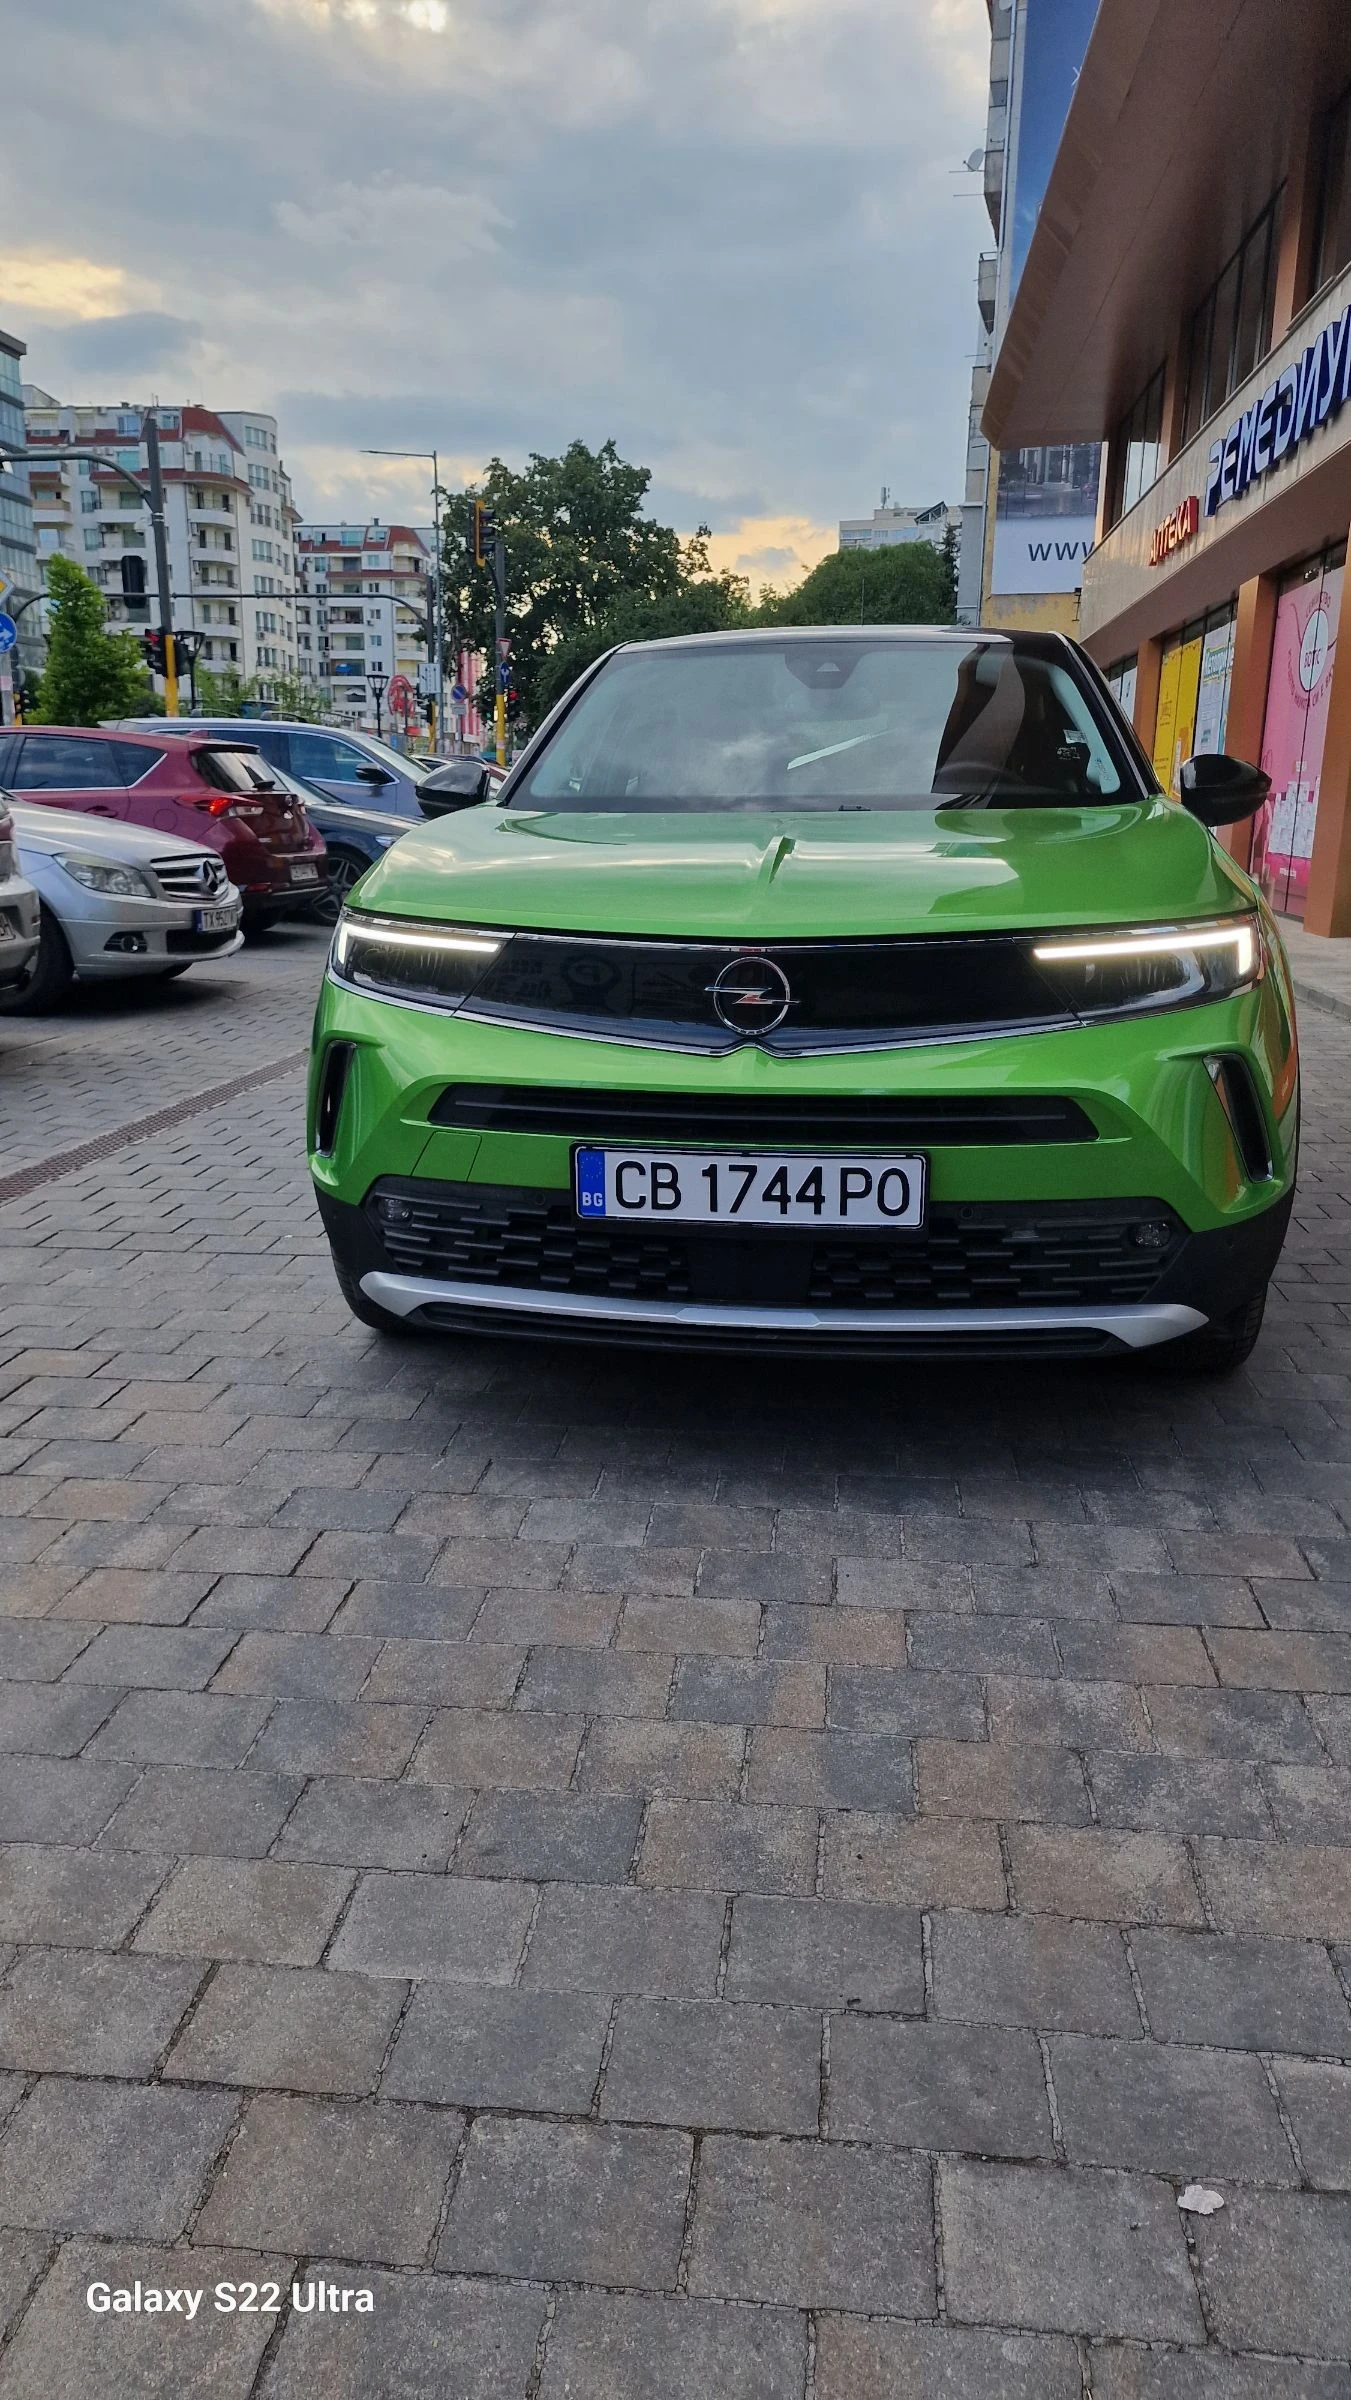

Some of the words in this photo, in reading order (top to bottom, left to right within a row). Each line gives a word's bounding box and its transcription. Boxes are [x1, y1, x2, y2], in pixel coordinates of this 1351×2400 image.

[1204, 305, 1351, 517] РЕМЕДИУ
[1149, 496, 1198, 566] АПТЕКА
[582, 1191, 604, 1207] BG
[615, 1160, 682, 1211] CB
[701, 1163, 826, 1215] 1744
[839, 1166, 911, 1217] PO
